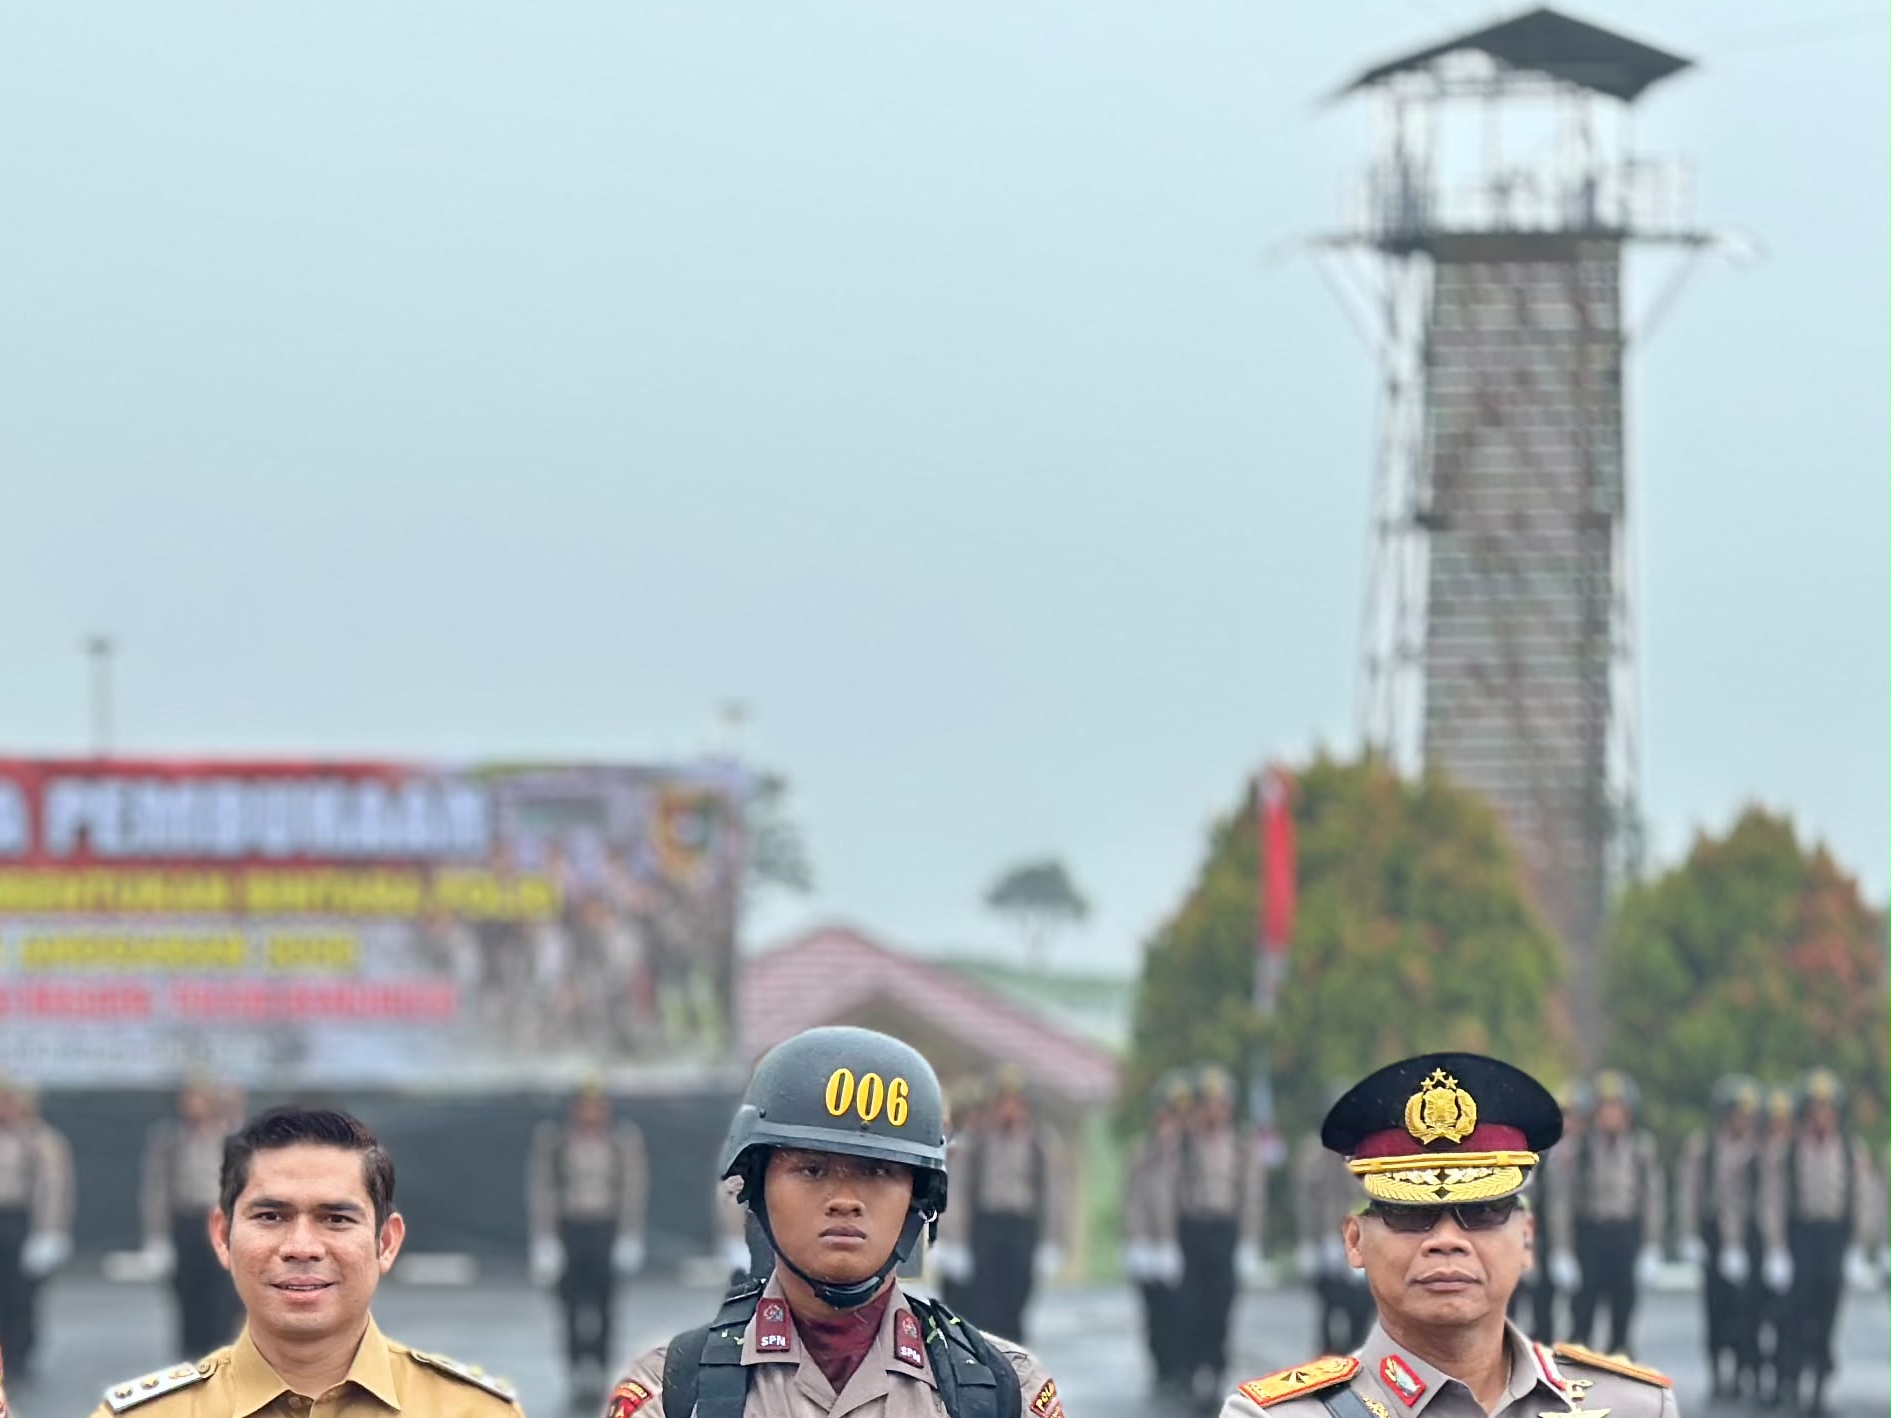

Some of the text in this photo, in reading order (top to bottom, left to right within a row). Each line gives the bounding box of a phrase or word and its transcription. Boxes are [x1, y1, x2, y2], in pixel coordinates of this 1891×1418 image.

[825, 1068, 909, 1127] 006
[760, 1335, 786, 1347] SPN
[900, 1346, 921, 1363] SPN
